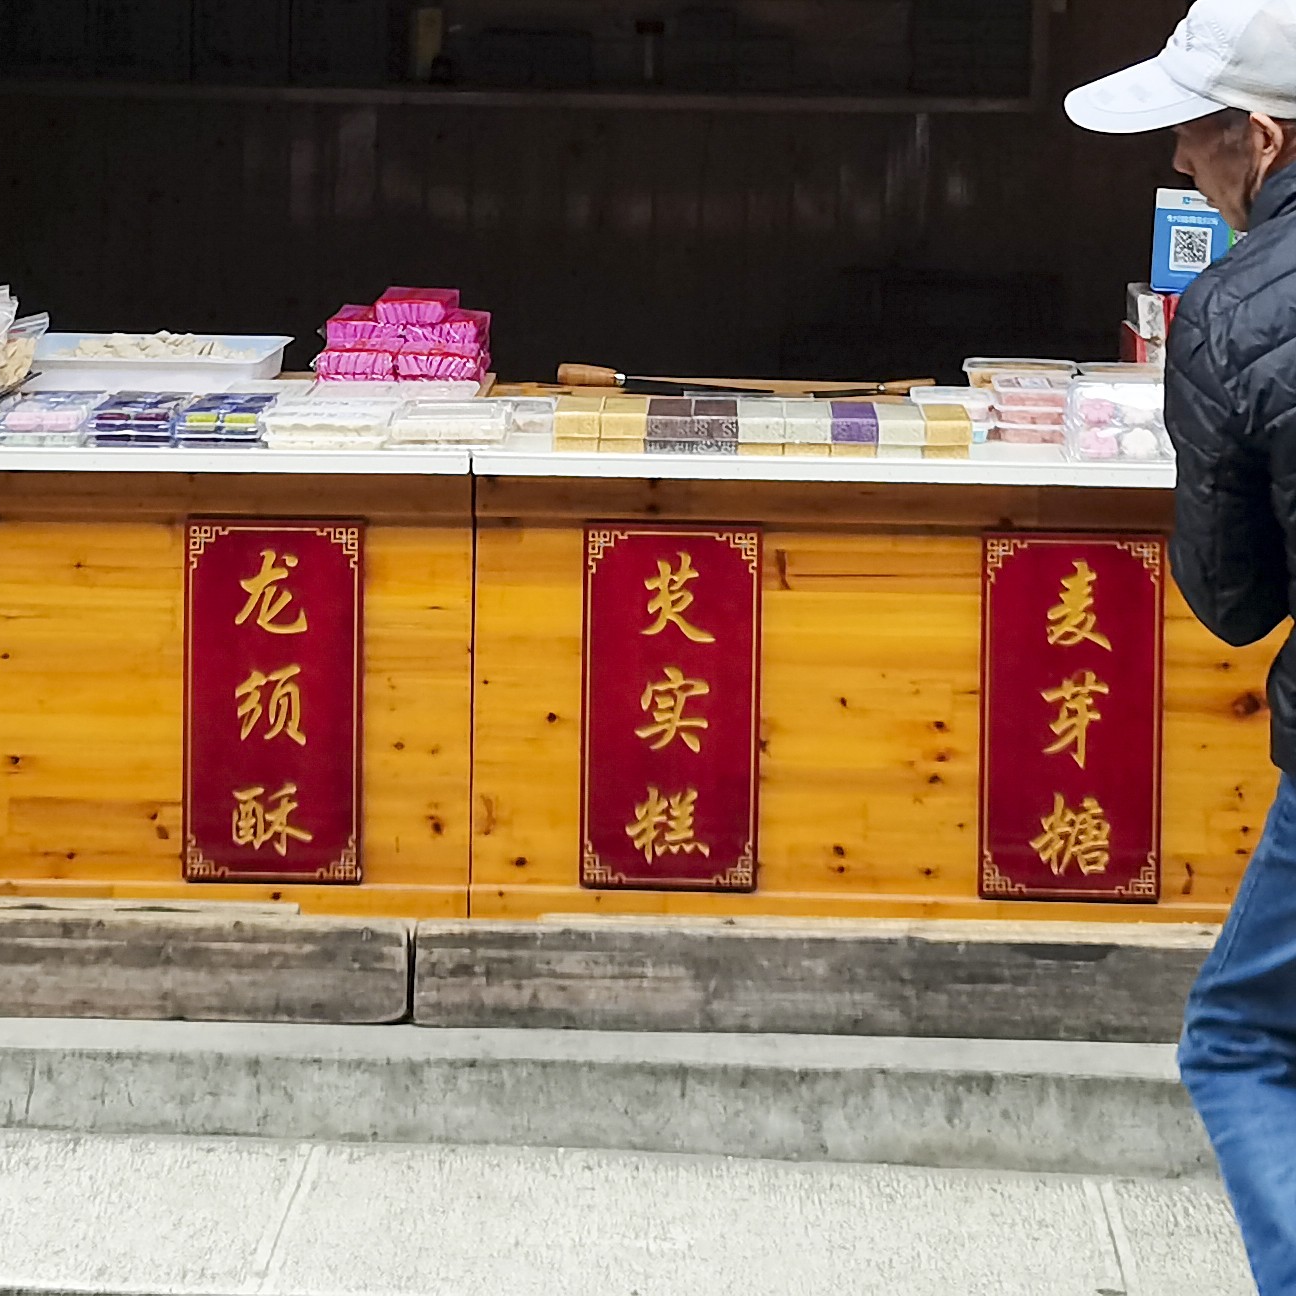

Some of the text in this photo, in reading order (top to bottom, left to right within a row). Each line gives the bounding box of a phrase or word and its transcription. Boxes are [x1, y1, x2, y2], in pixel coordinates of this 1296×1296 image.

[230, 549, 313, 857] 龙须酥
[625, 551, 716, 865] 芡实糕
[1029, 560, 1113, 877] 麦芽糖
